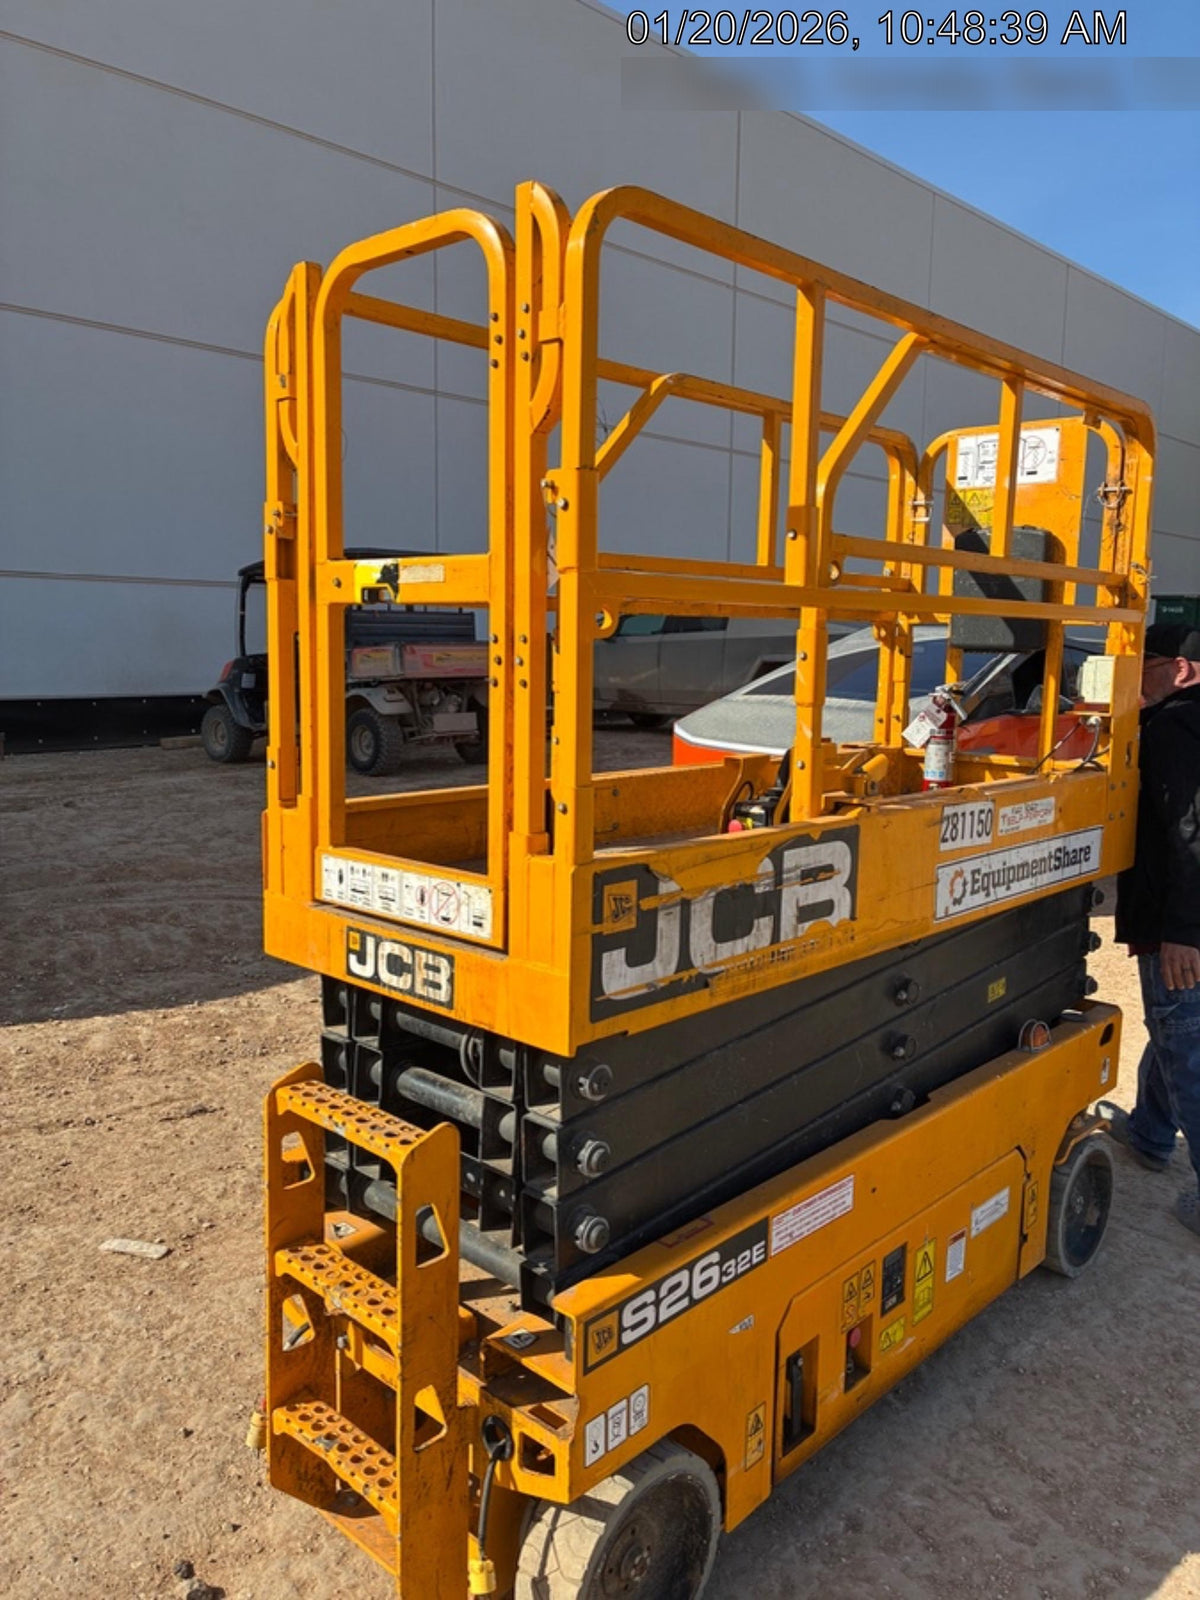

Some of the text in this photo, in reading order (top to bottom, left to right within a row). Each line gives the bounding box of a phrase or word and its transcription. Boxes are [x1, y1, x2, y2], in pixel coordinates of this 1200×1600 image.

[940, 808, 993, 844] 281150
[969, 845, 1092, 898] EquipmentShare
[602, 840, 852, 1001] JCB
[349, 935, 451, 1003] JCB
